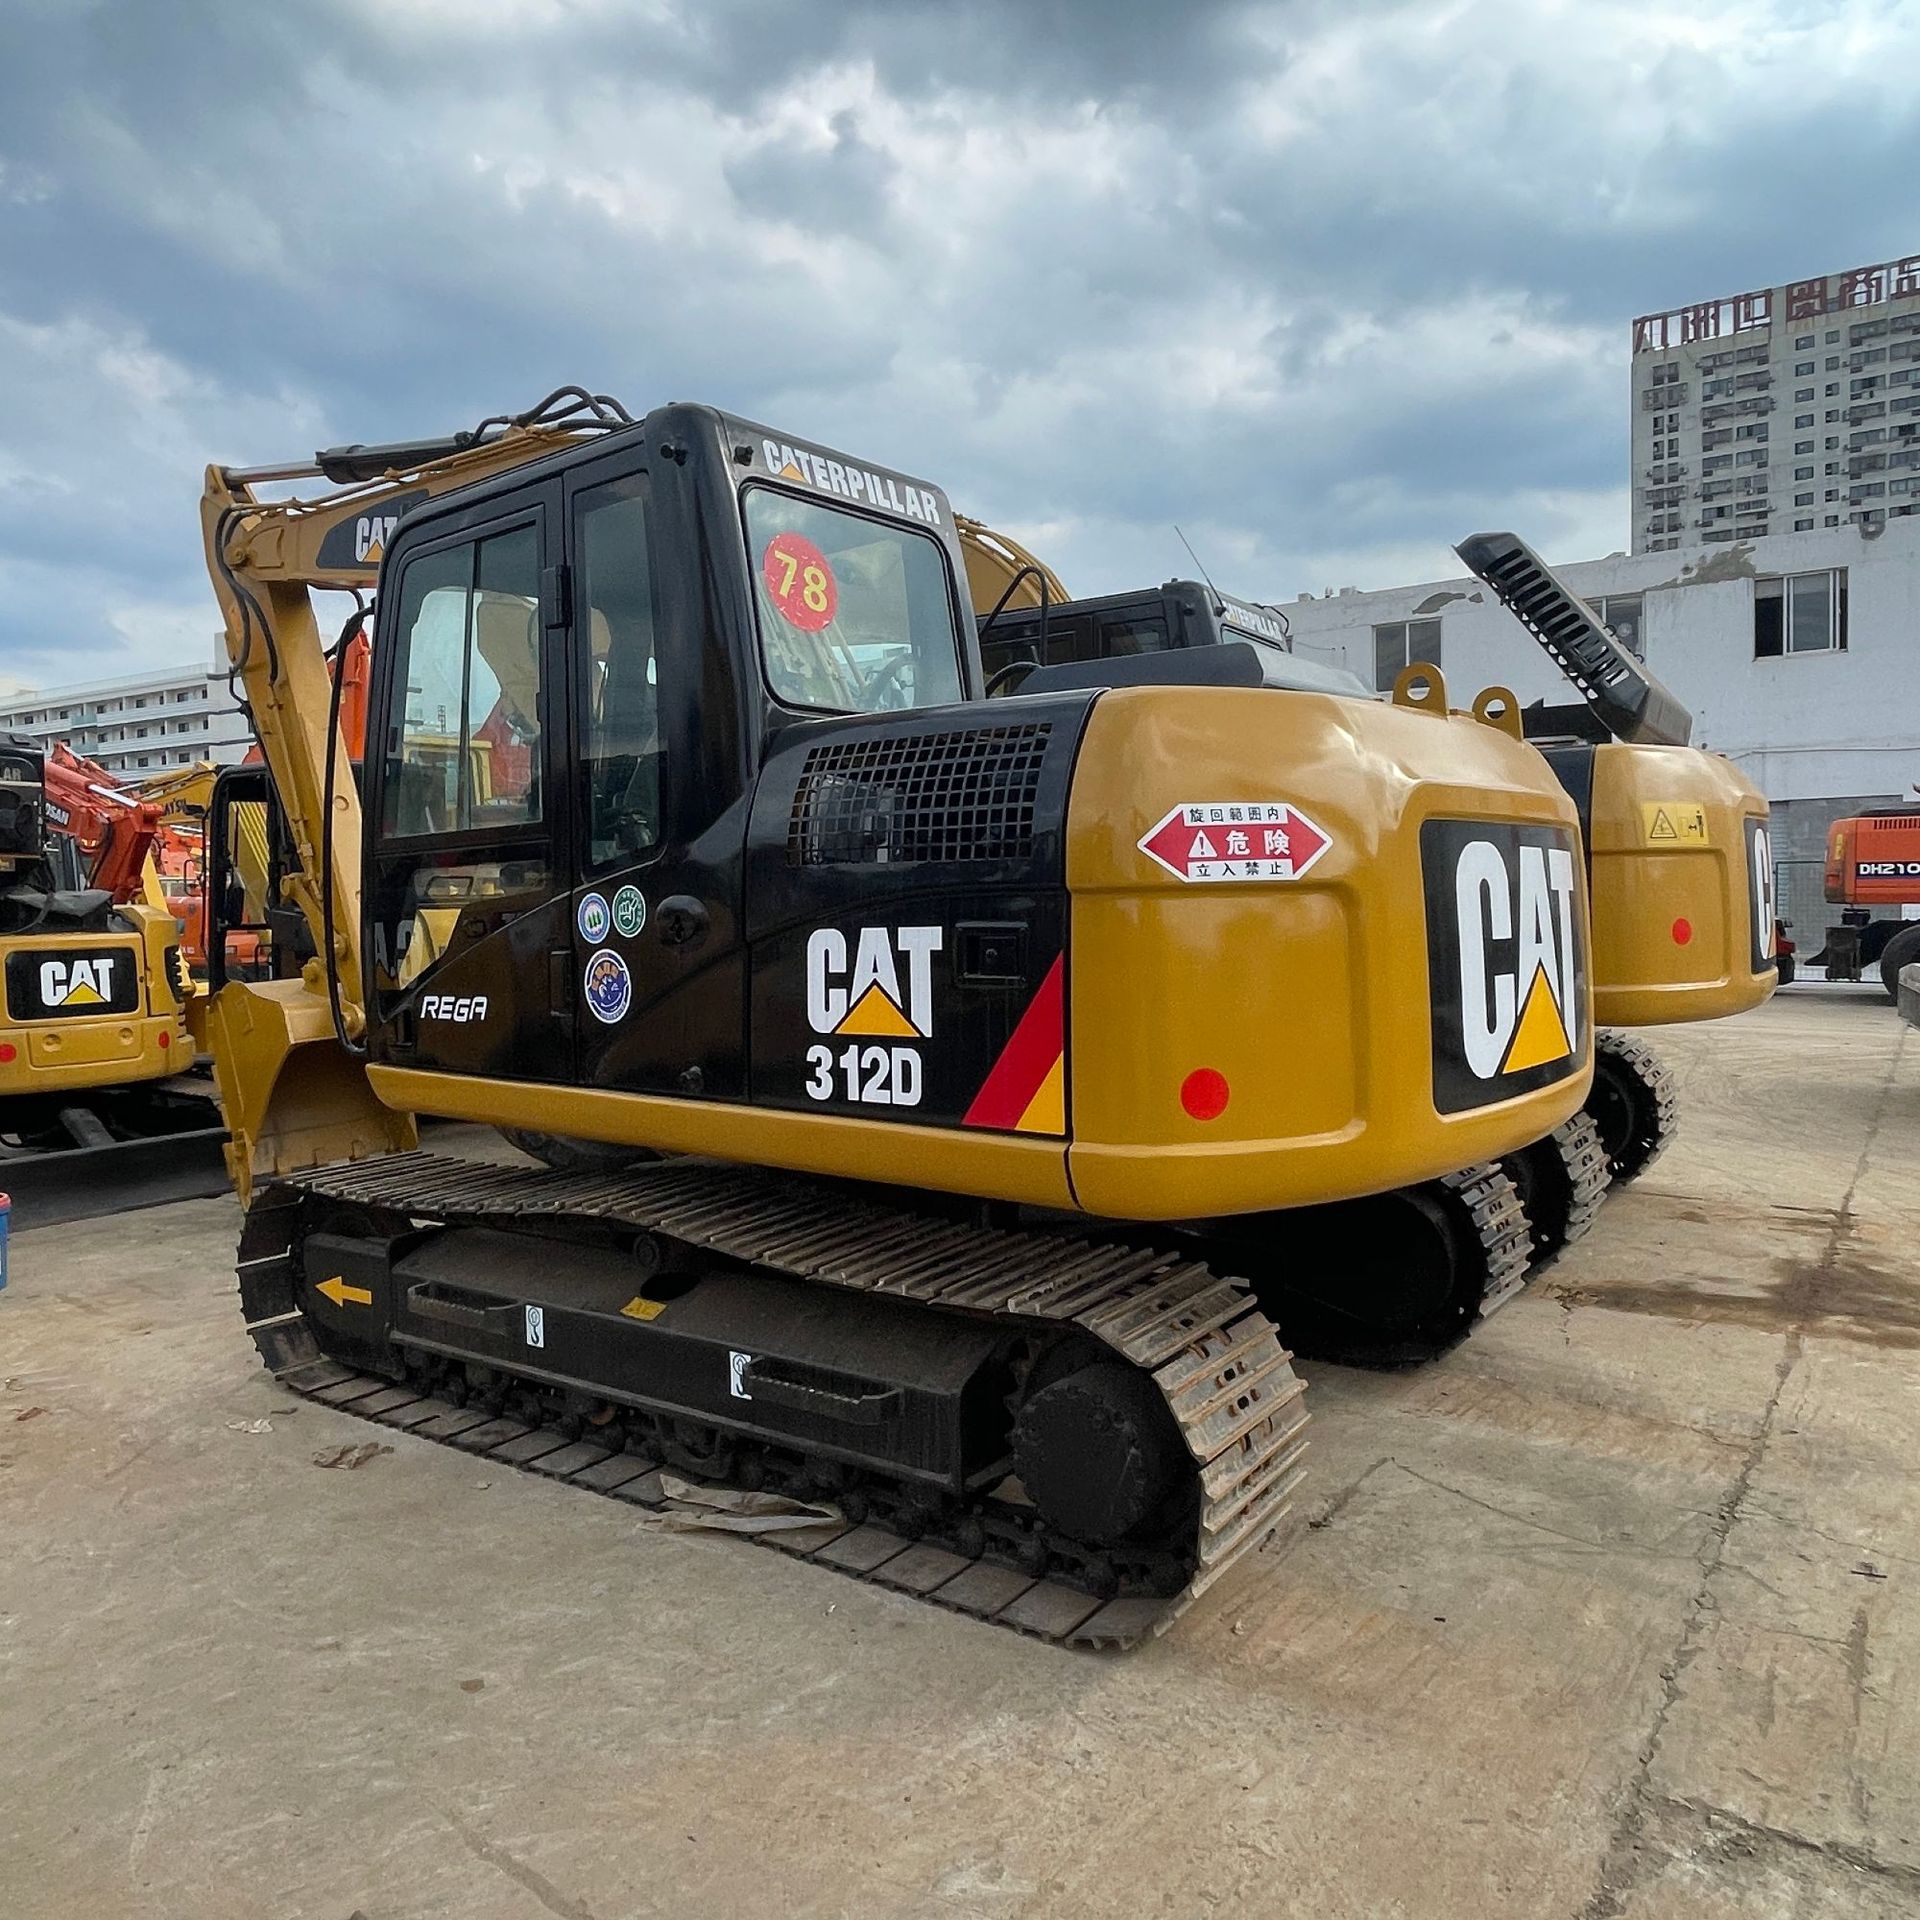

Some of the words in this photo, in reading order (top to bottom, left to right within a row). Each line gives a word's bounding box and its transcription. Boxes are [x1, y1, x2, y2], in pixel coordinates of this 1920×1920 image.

[762, 440, 941, 525] CATERPILLAR
[774, 550, 828, 612] 78
[1189, 807, 1280, 823] 旋回範囲内
[1196, 861, 1284, 878] 立入禁止
[1225, 829, 1291, 856] 危険
[40, 959, 114, 1006] CAT
[807, 926, 942, 1037] CAT
[1456, 841, 1576, 1079] CAT
[420, 995, 488, 1022] REGA
[806, 1045, 922, 1106] 312D
